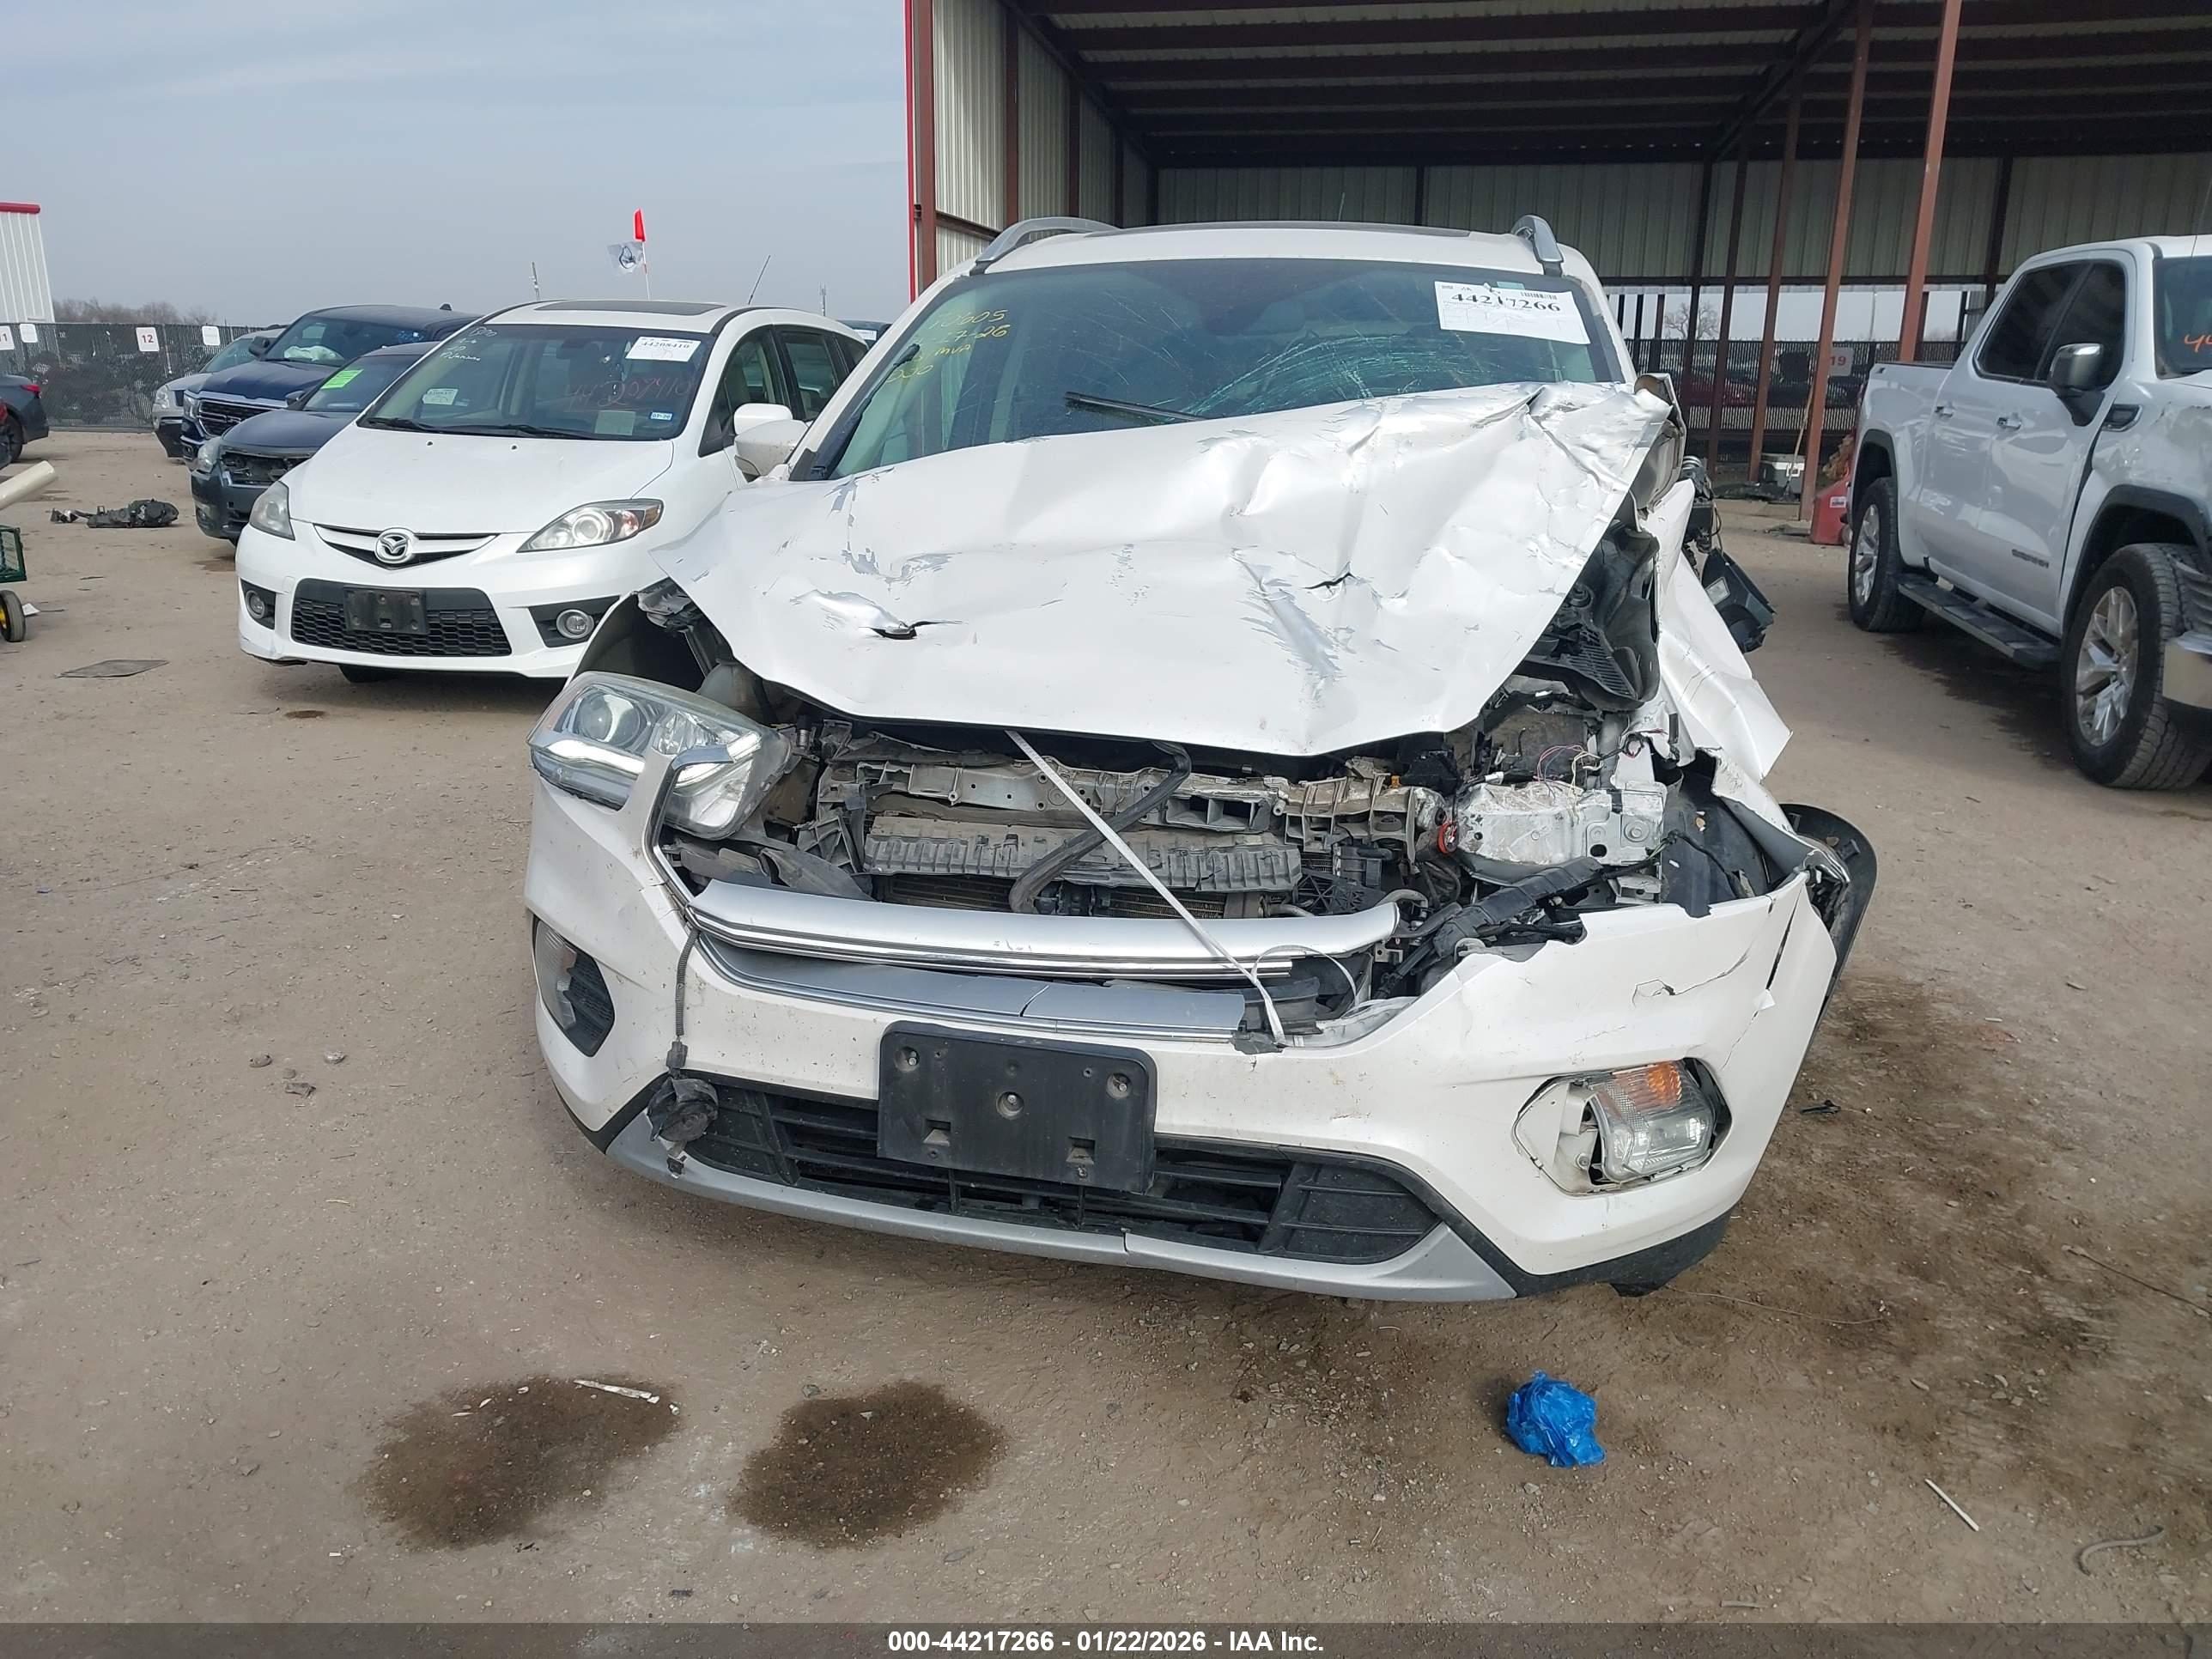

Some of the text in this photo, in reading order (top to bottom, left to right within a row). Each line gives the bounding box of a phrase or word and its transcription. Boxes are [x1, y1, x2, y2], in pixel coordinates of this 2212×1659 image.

[1451, 293, 1561, 312] 44217266
[142, 335, 154, 343] 12
[1830, 356, 1846, 366] 19
